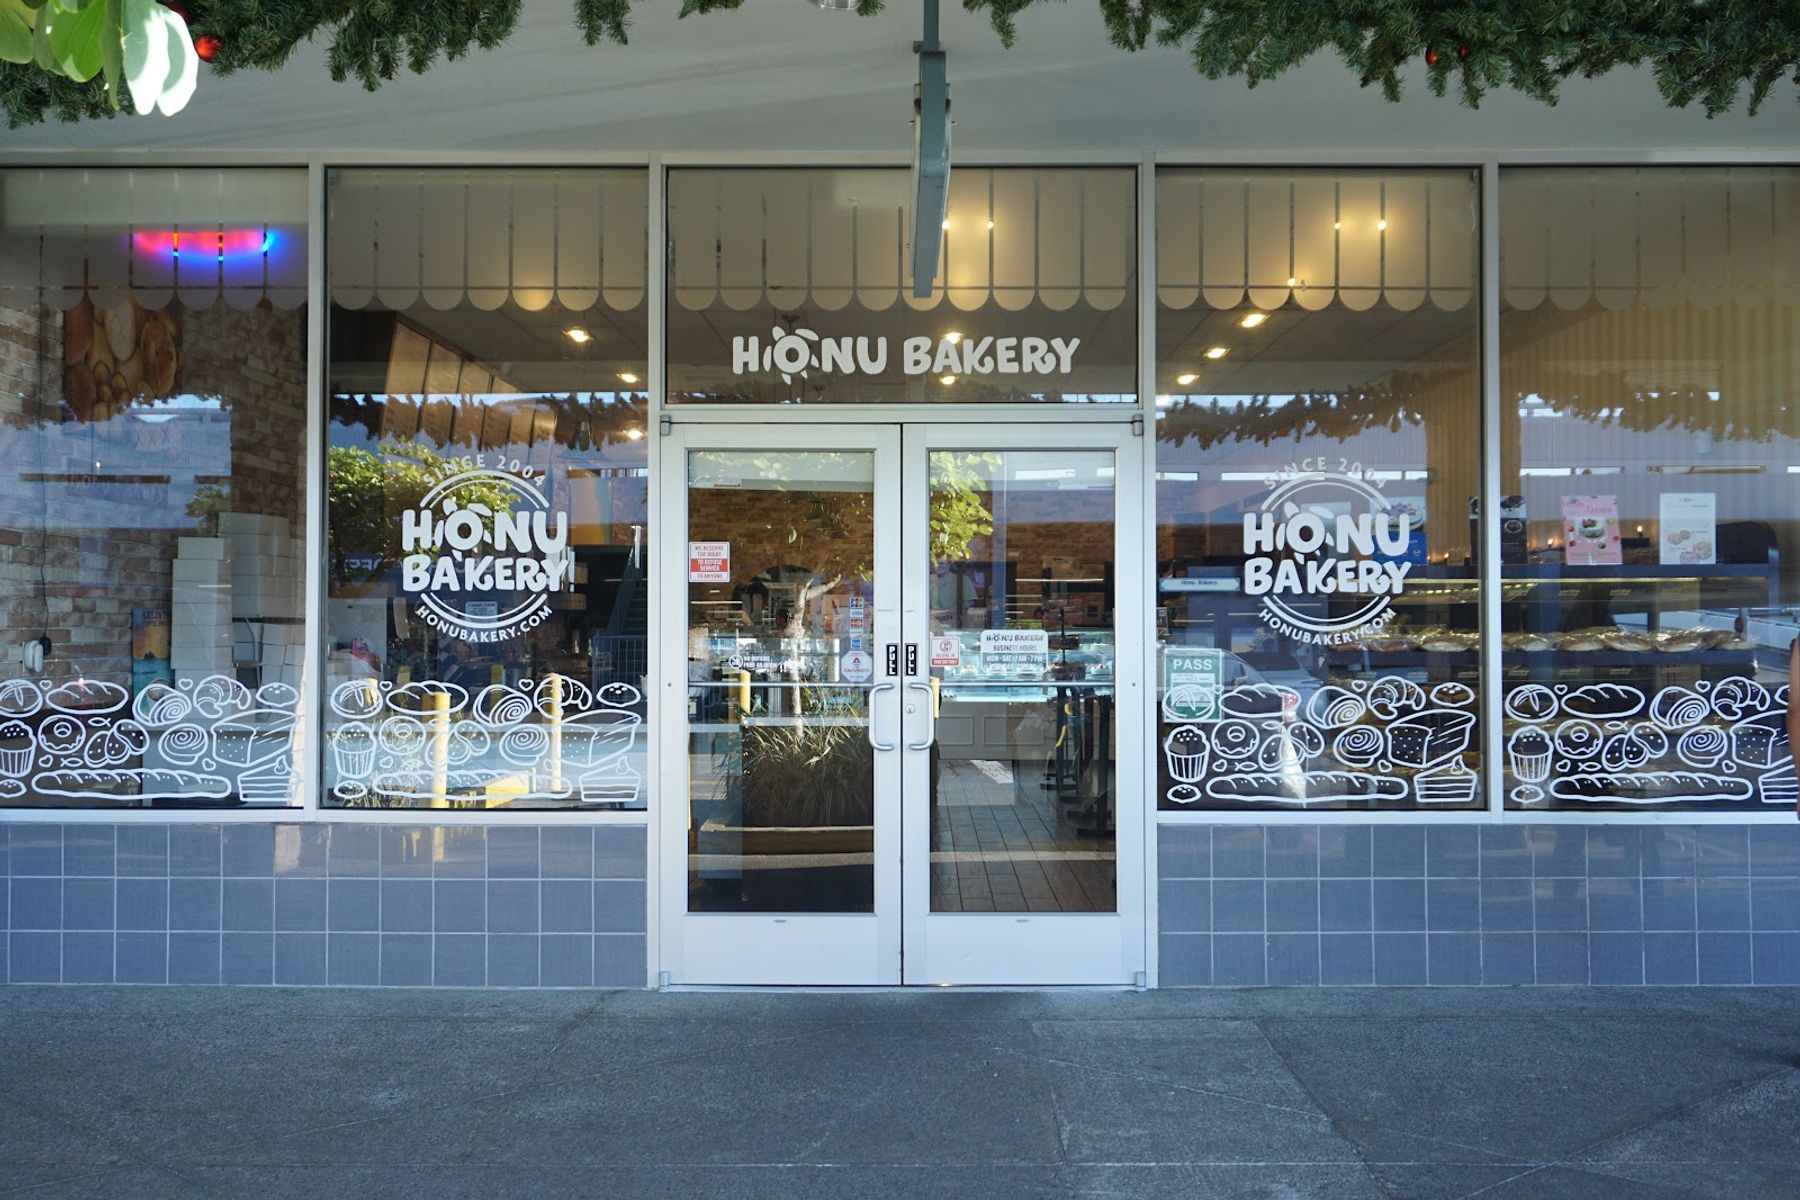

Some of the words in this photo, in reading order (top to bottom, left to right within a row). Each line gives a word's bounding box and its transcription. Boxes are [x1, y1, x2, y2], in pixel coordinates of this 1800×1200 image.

[732, 334, 888, 376] HONU
[903, 335, 1081, 375] BAKERY
[423, 454, 486, 487] SINCE
[497, 455, 546, 486] 2004
[1264, 456, 1327, 490] SINCE
[1338, 458, 1387, 489] 2004
[402, 508, 568, 554] HONU
[1243, 512, 1410, 557] HONU
[402, 554, 569, 592] BAKERY
[1244, 557, 1412, 595] BAKERY
[415, 605, 553, 643] HONUBAKERY.COM
[986, 633, 1013, 642] HONU
[1014, 634, 1044, 642] BAKERY
[1173, 659, 1213, 670] PASS
